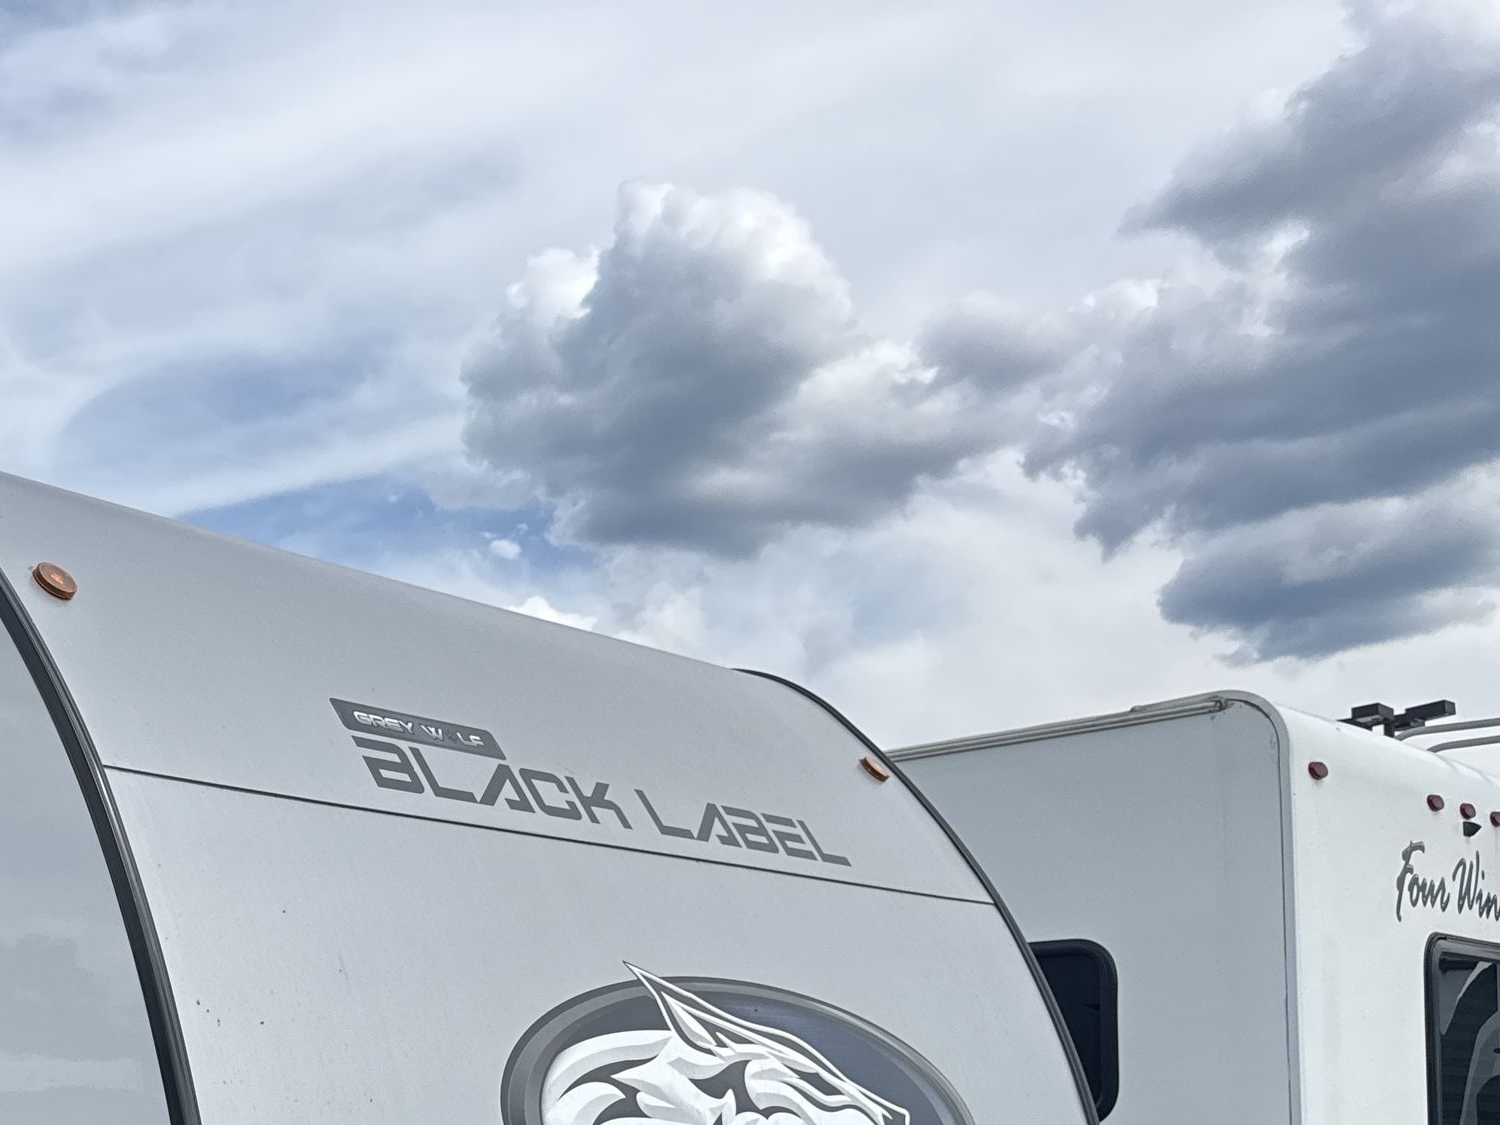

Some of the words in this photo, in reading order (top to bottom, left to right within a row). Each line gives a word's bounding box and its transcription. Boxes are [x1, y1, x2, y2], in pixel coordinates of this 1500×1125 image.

[353, 710, 415, 735] GREY
[420, 723, 485, 748] WLF
[351, 735, 633, 830] BLACK
[634, 789, 852, 867] LABEL
[1396, 840, 1450, 922] Four
